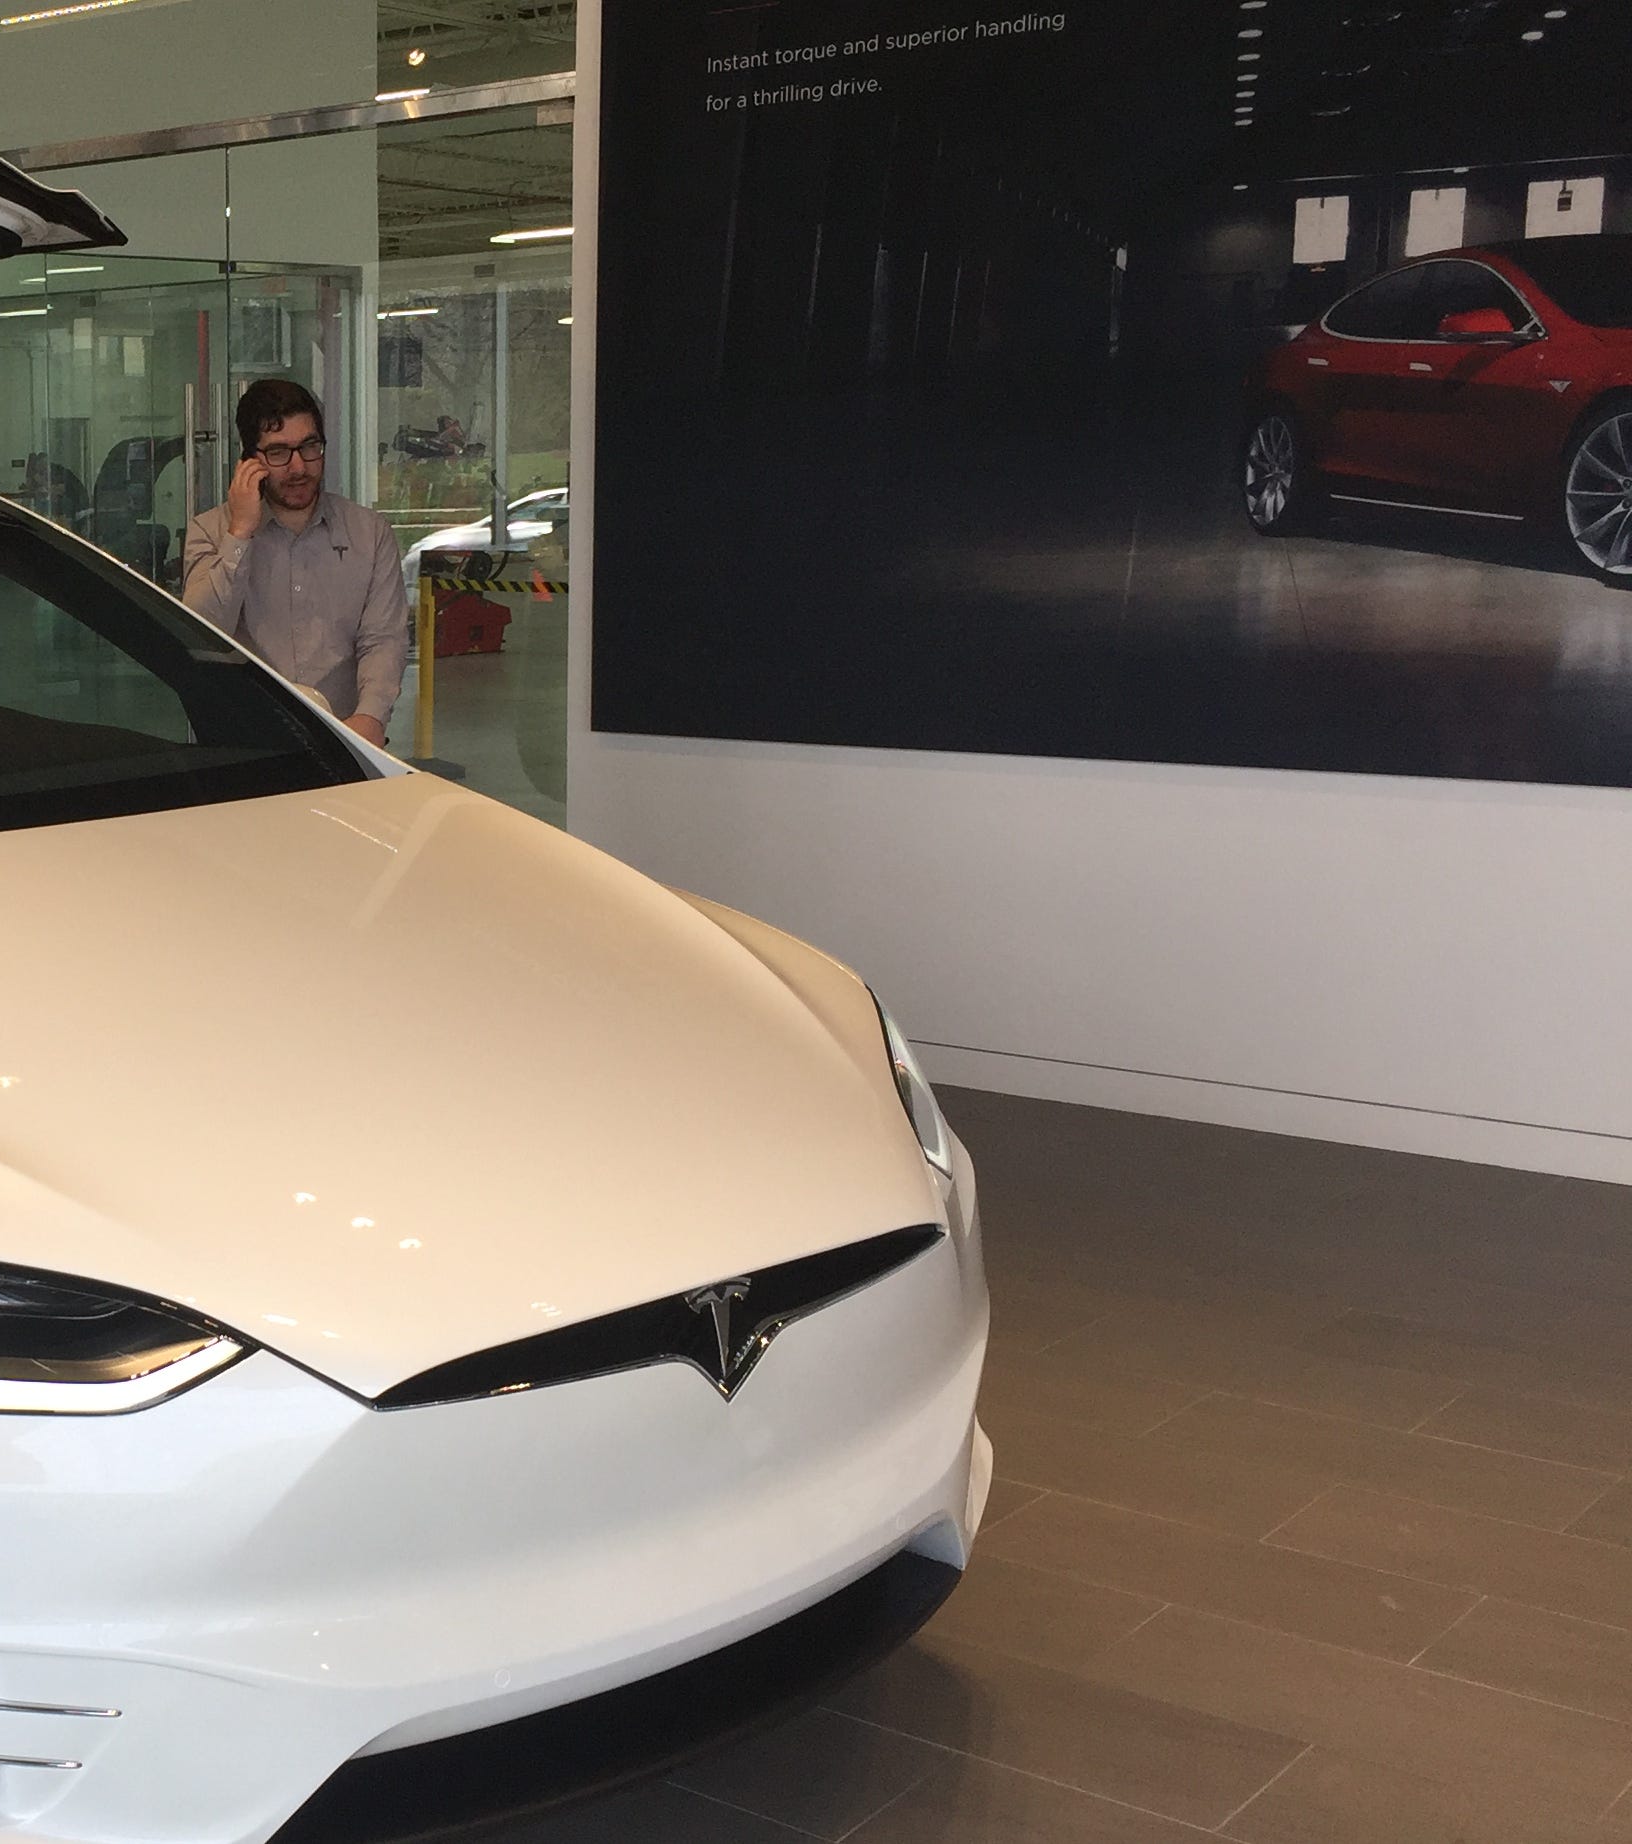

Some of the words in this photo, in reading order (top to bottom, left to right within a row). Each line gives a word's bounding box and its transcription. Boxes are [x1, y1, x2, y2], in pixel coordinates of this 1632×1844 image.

[706, 50, 770, 74] Instant
[774, 43, 837, 65] torque
[843, 33, 879, 56] and
[885, 25, 969, 51] superior
[974, 12, 1066, 39] handling
[705, 94, 732, 112] for
[736, 95, 748, 109] a
[752, 81, 824, 107] thrilling
[829, 77, 884, 98] drive.
